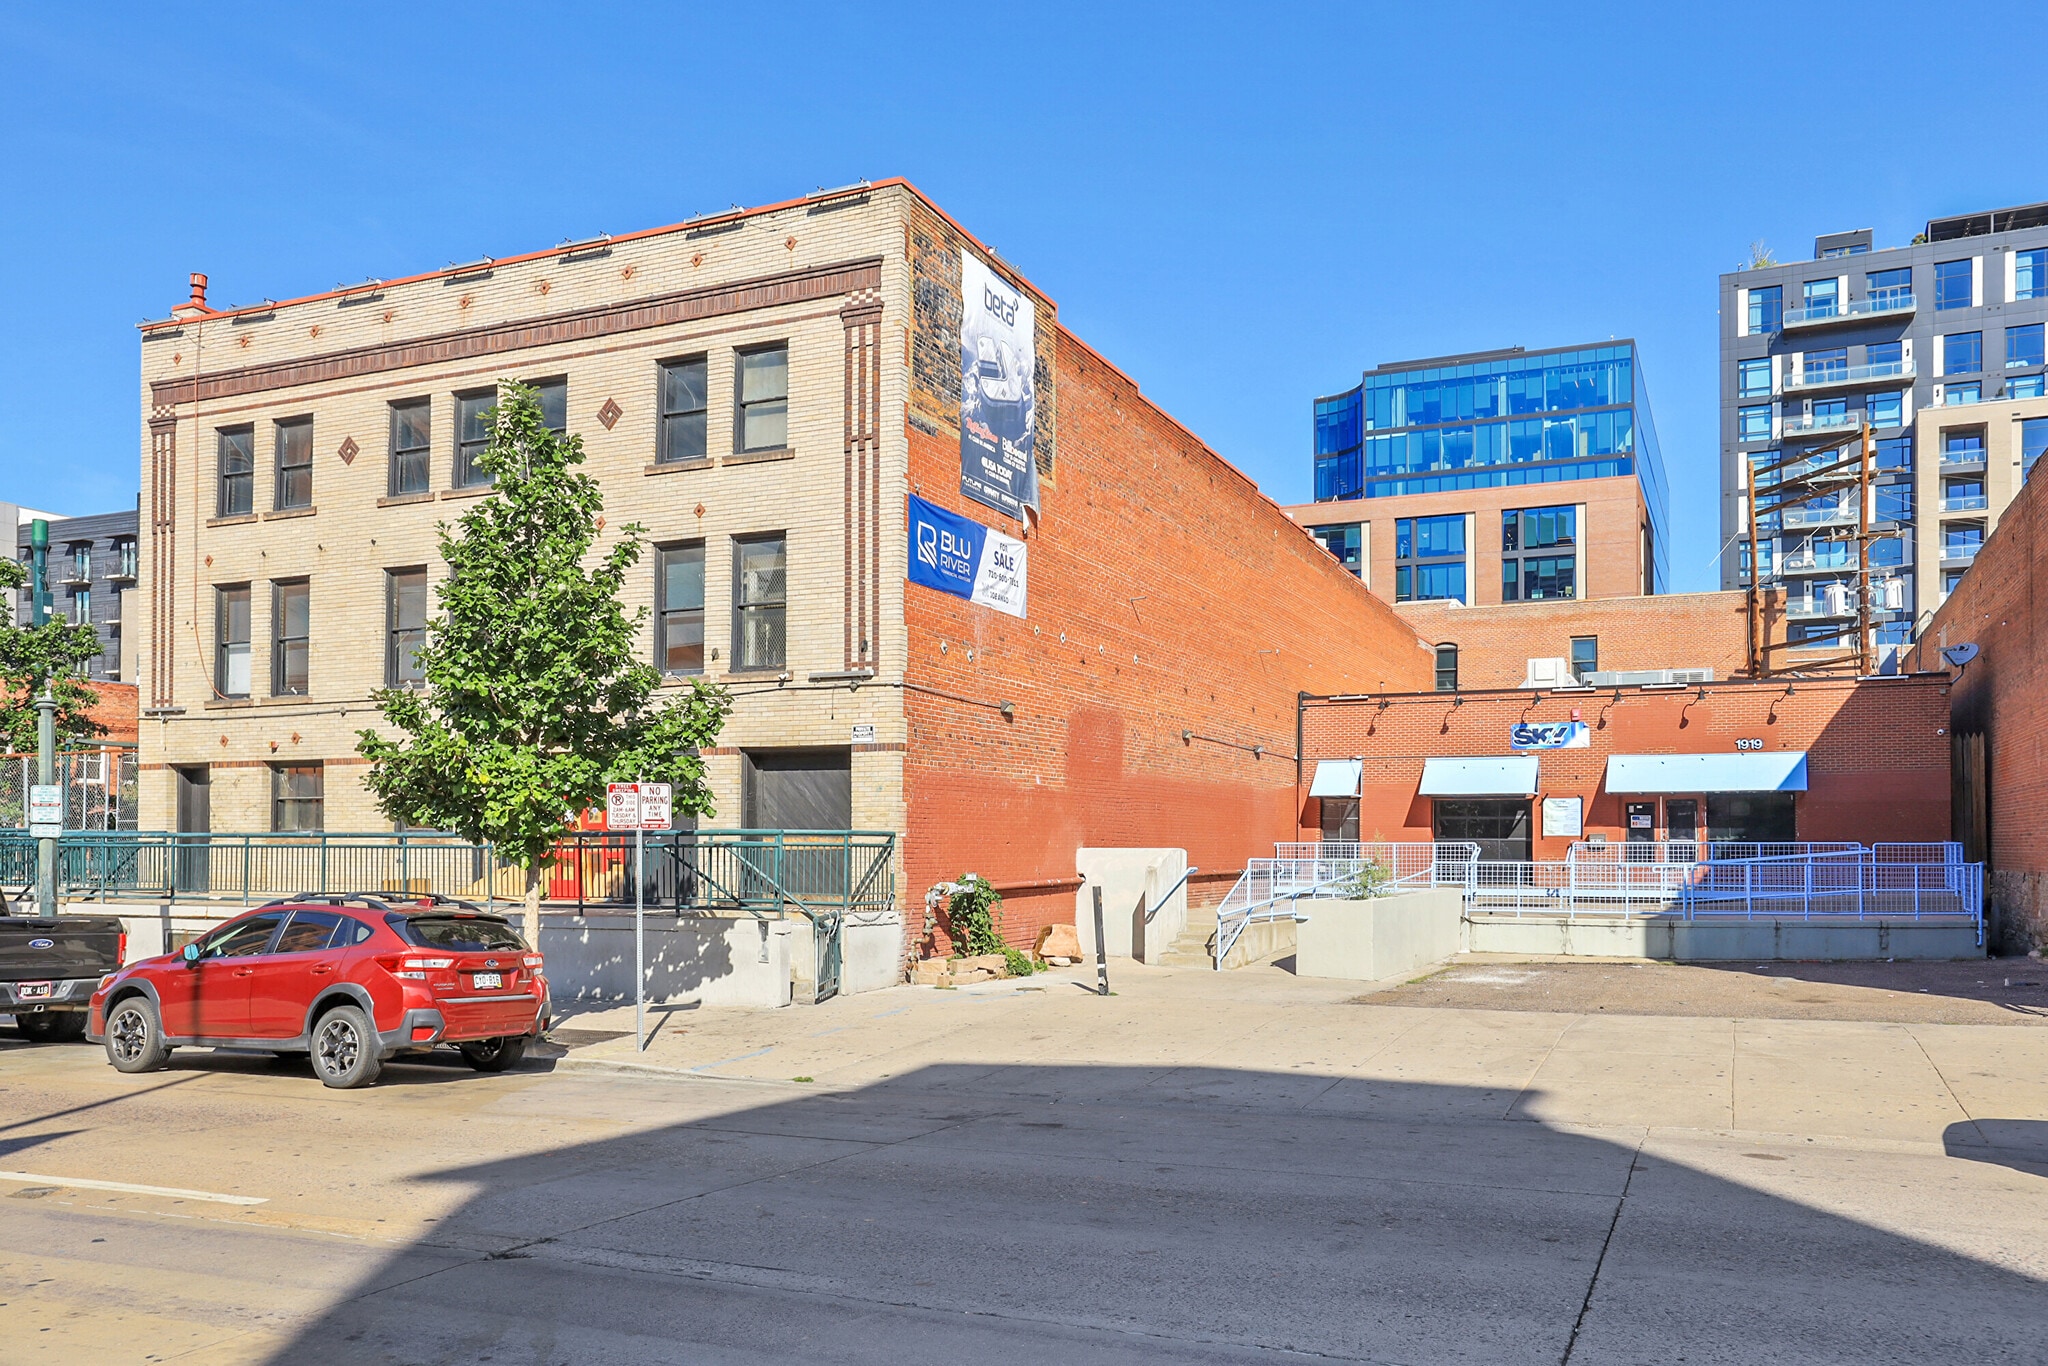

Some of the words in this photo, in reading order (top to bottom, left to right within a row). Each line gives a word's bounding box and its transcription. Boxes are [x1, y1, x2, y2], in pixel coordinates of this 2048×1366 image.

[985, 282, 1014, 327] beta
[941, 530, 971, 560] BLU
[1000, 542, 1008, 552] FOR
[941, 553, 971, 576] RIVER
[994, 550, 1014, 572] SALE
[1735, 738, 1763, 750] 1919
[649, 787, 660, 795] NO
[642, 796, 668, 804] PARKING
